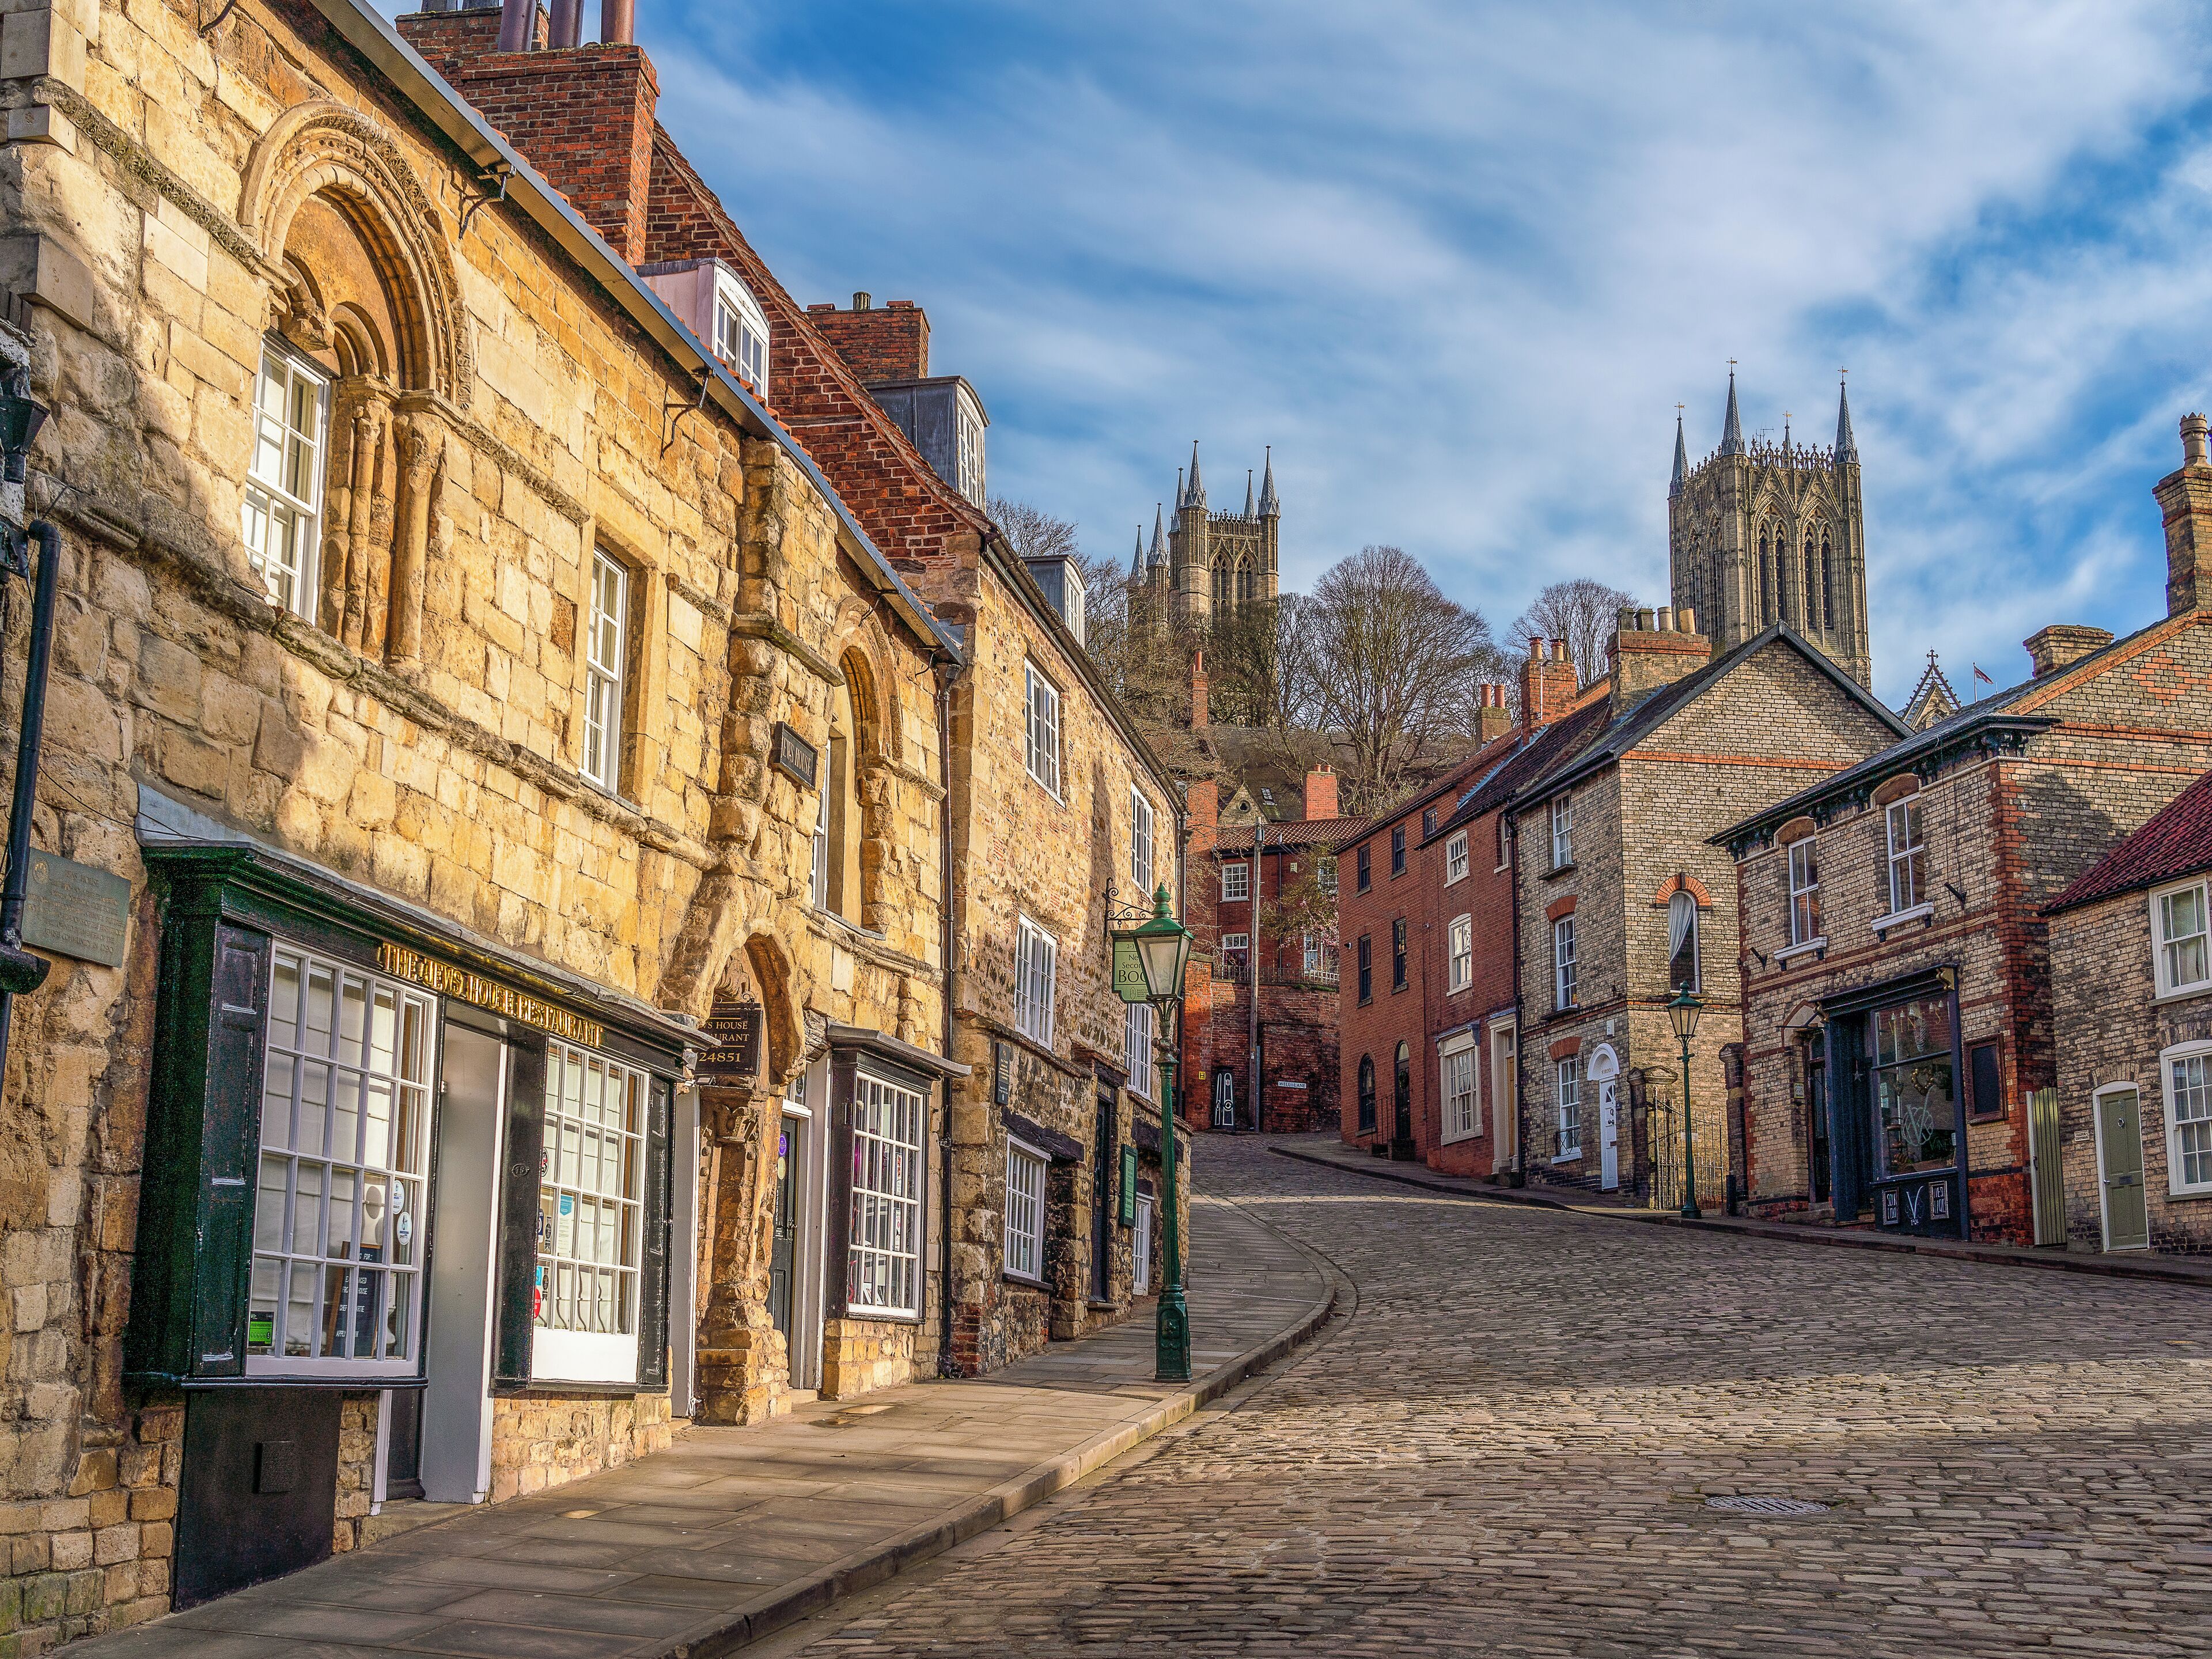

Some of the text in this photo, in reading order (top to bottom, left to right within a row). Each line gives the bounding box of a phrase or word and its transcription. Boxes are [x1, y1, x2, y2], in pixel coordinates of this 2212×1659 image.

[795, 747, 812, 777] HOUSE
[378, 942, 603, 1048] THE JEWS HOUSE RESTAURANT
[716, 1021, 748, 1029] HOUSE
[711, 1033, 750, 1041] URANT
[696, 1052, 741, 1062] 24851
